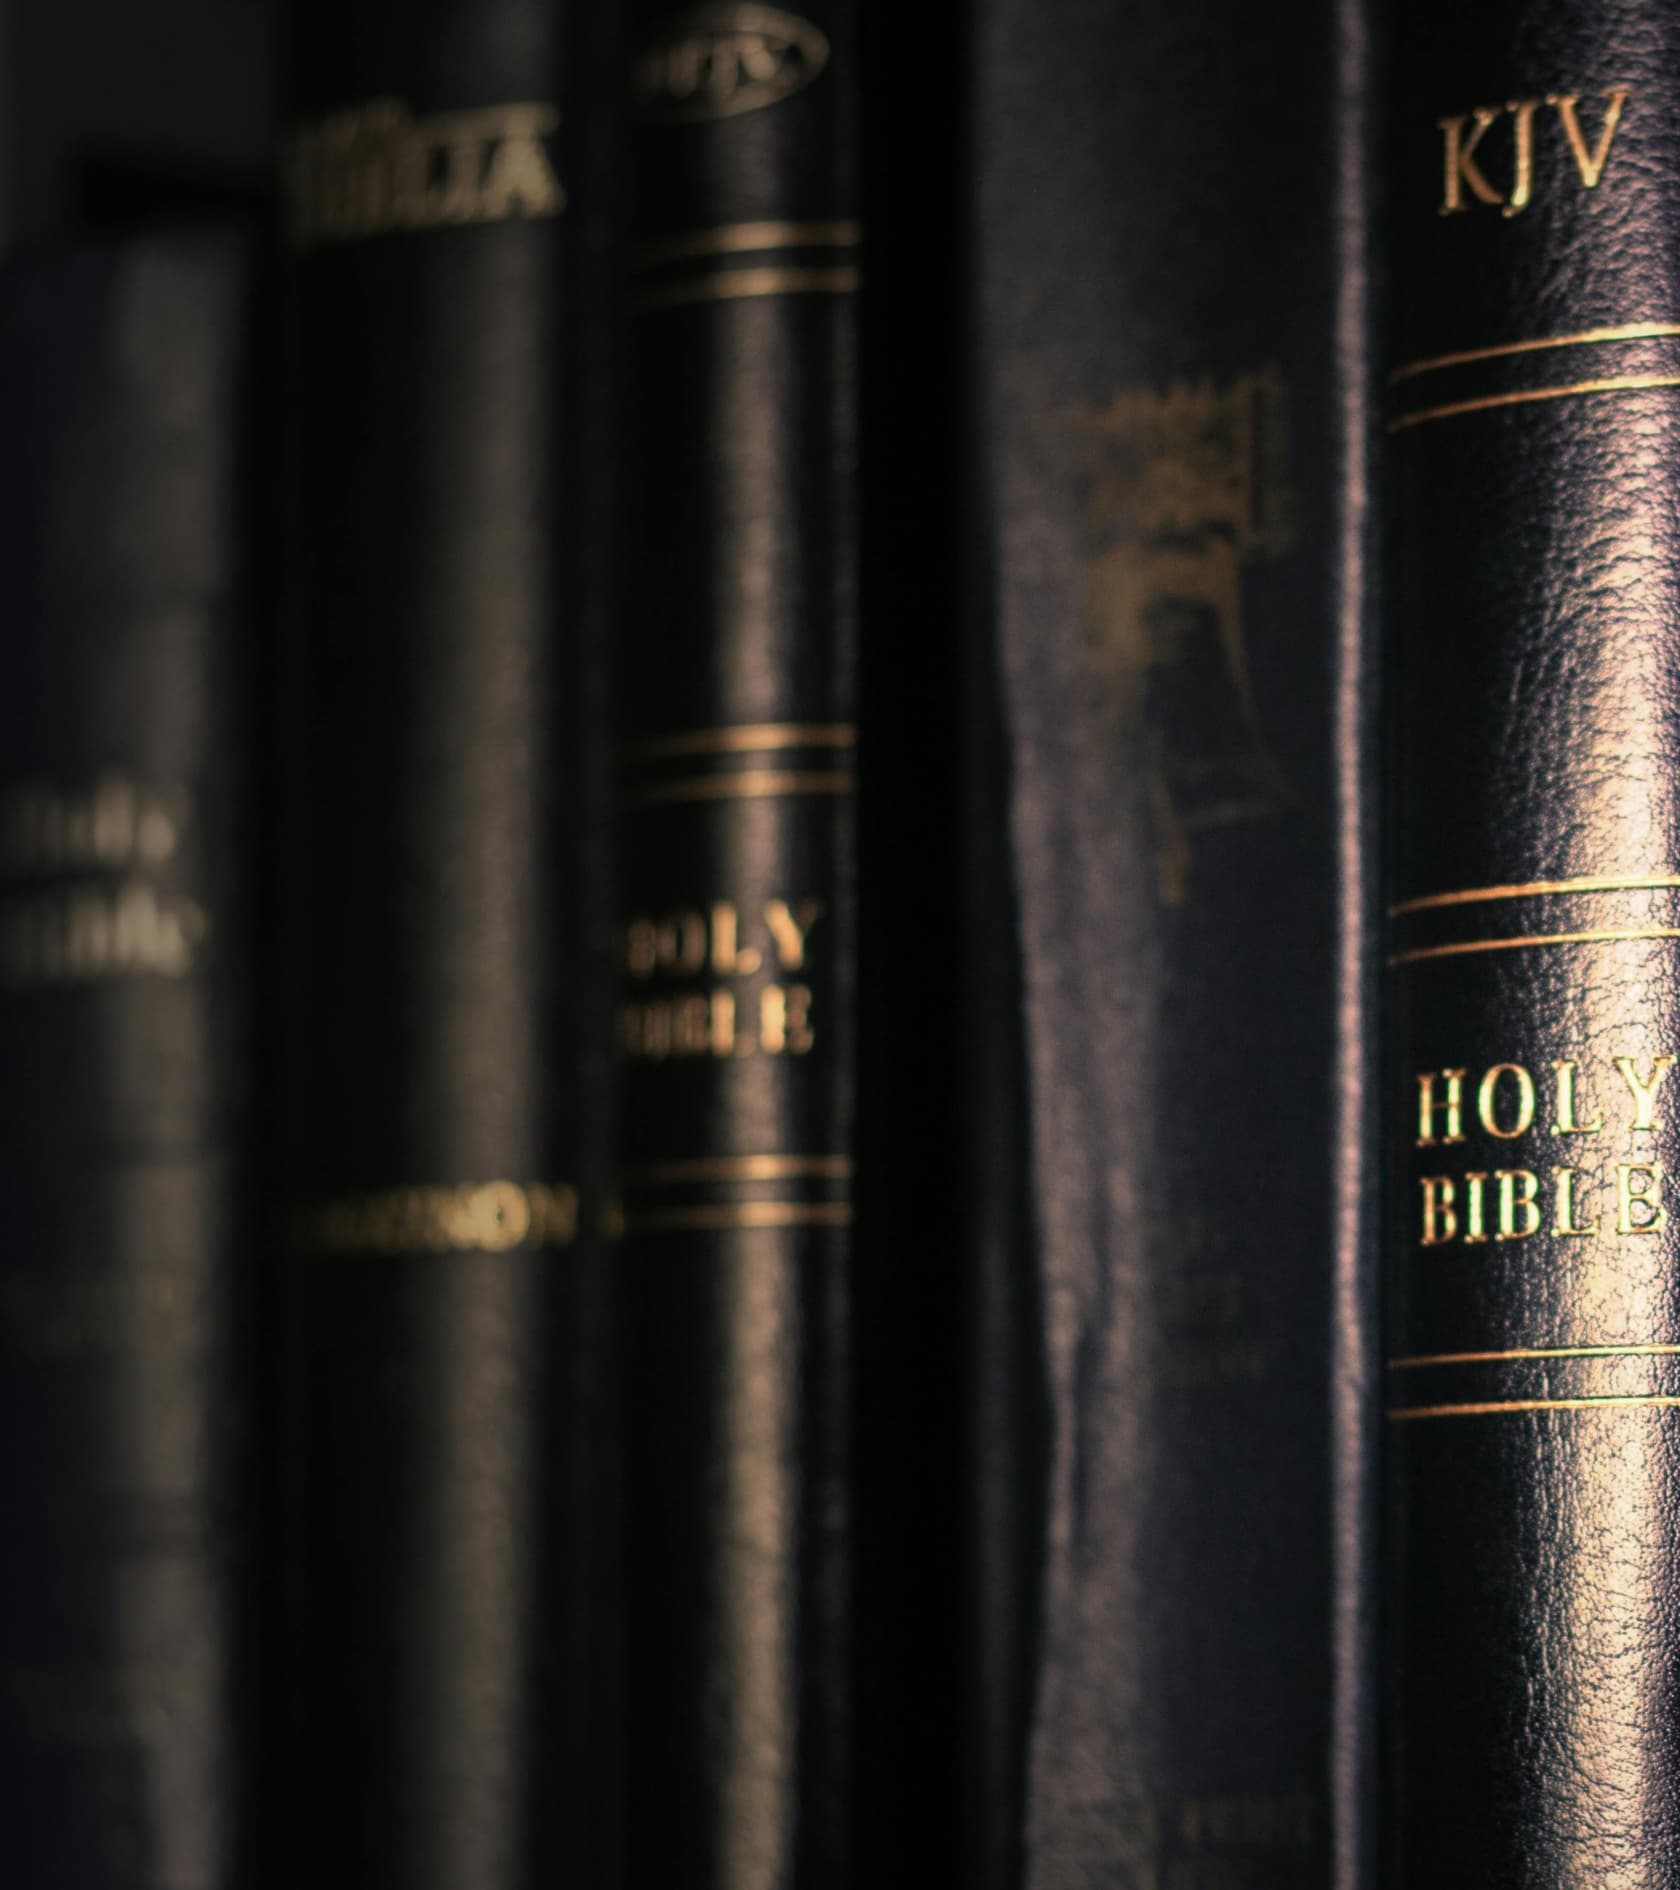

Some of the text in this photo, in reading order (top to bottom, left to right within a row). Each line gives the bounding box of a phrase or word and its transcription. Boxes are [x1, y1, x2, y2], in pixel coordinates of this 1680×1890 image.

[1438, 86, 1633, 217] KJV
[1417, 1056, 1675, 1146] HOLY
[1420, 1162, 1668, 1245] BIBLE
